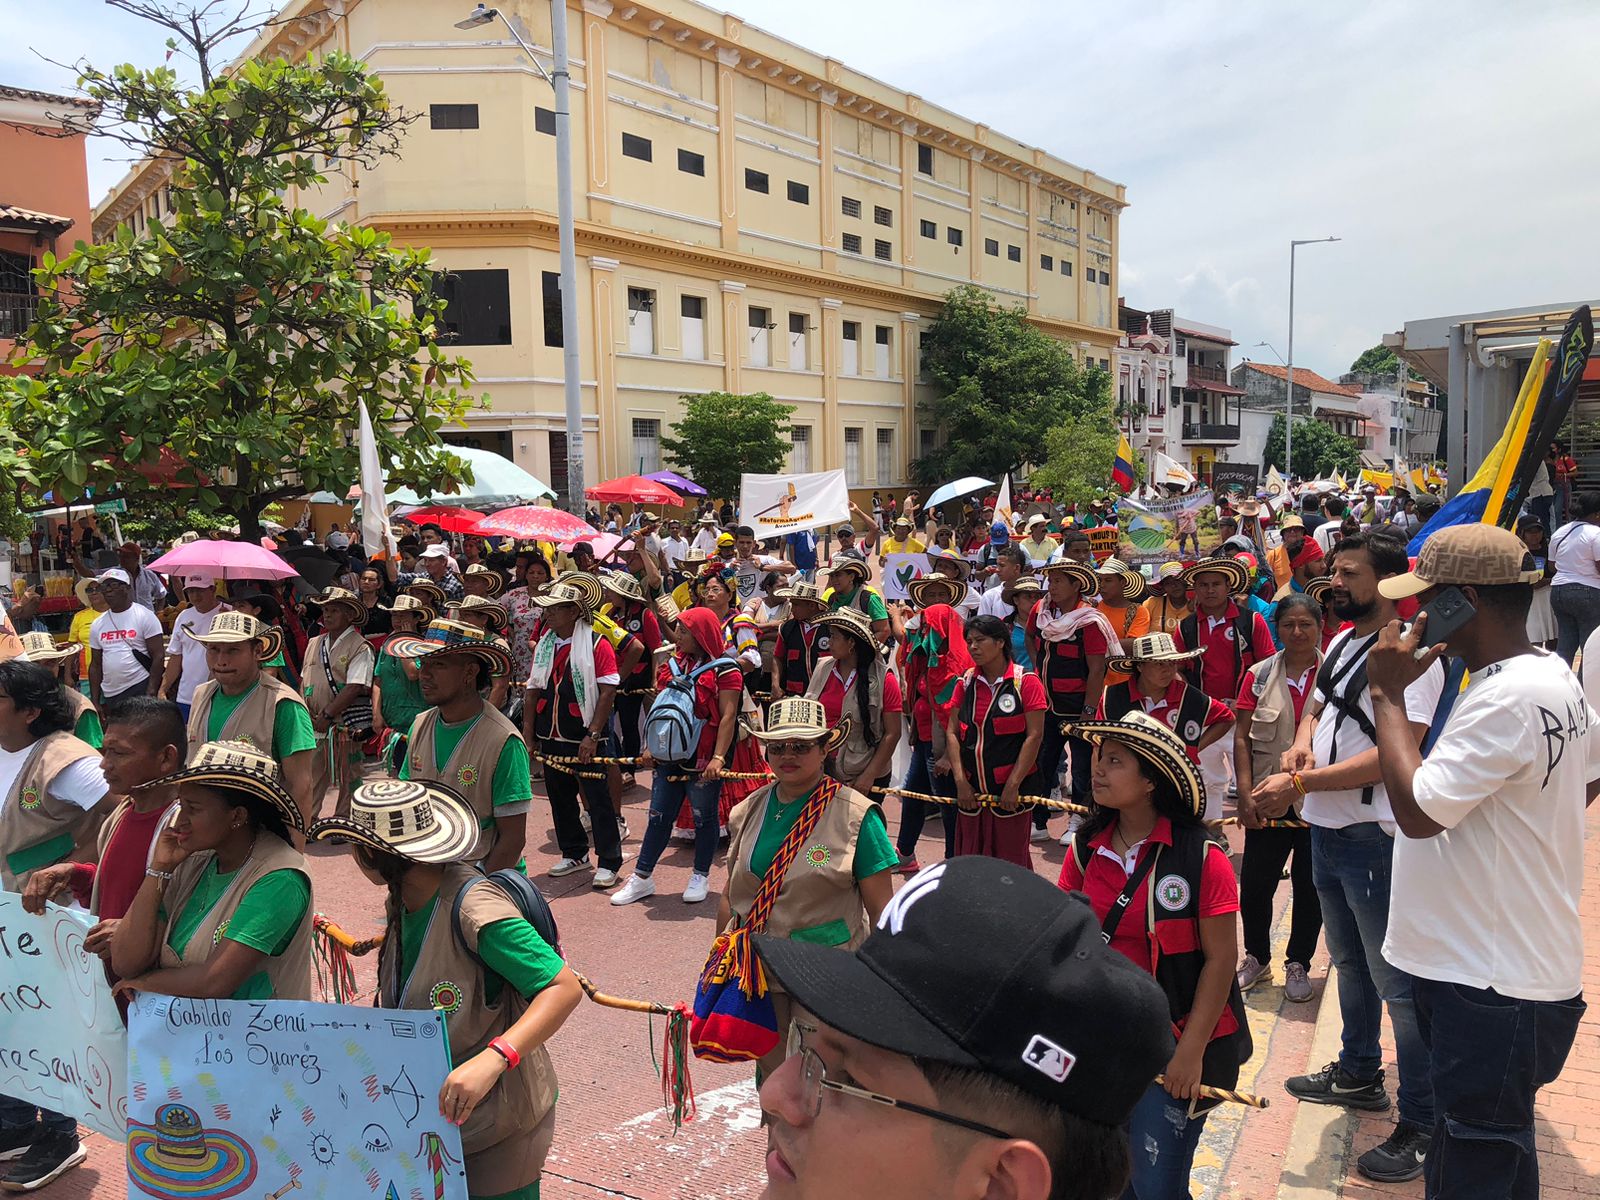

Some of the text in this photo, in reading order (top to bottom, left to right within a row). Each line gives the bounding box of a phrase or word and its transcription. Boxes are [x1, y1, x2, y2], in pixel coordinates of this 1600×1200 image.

[759, 513, 813, 524] #ReformaAgraria
[167, 998, 308, 1032] Cabildo Zenú
[200, 1032, 233, 1065] Los
